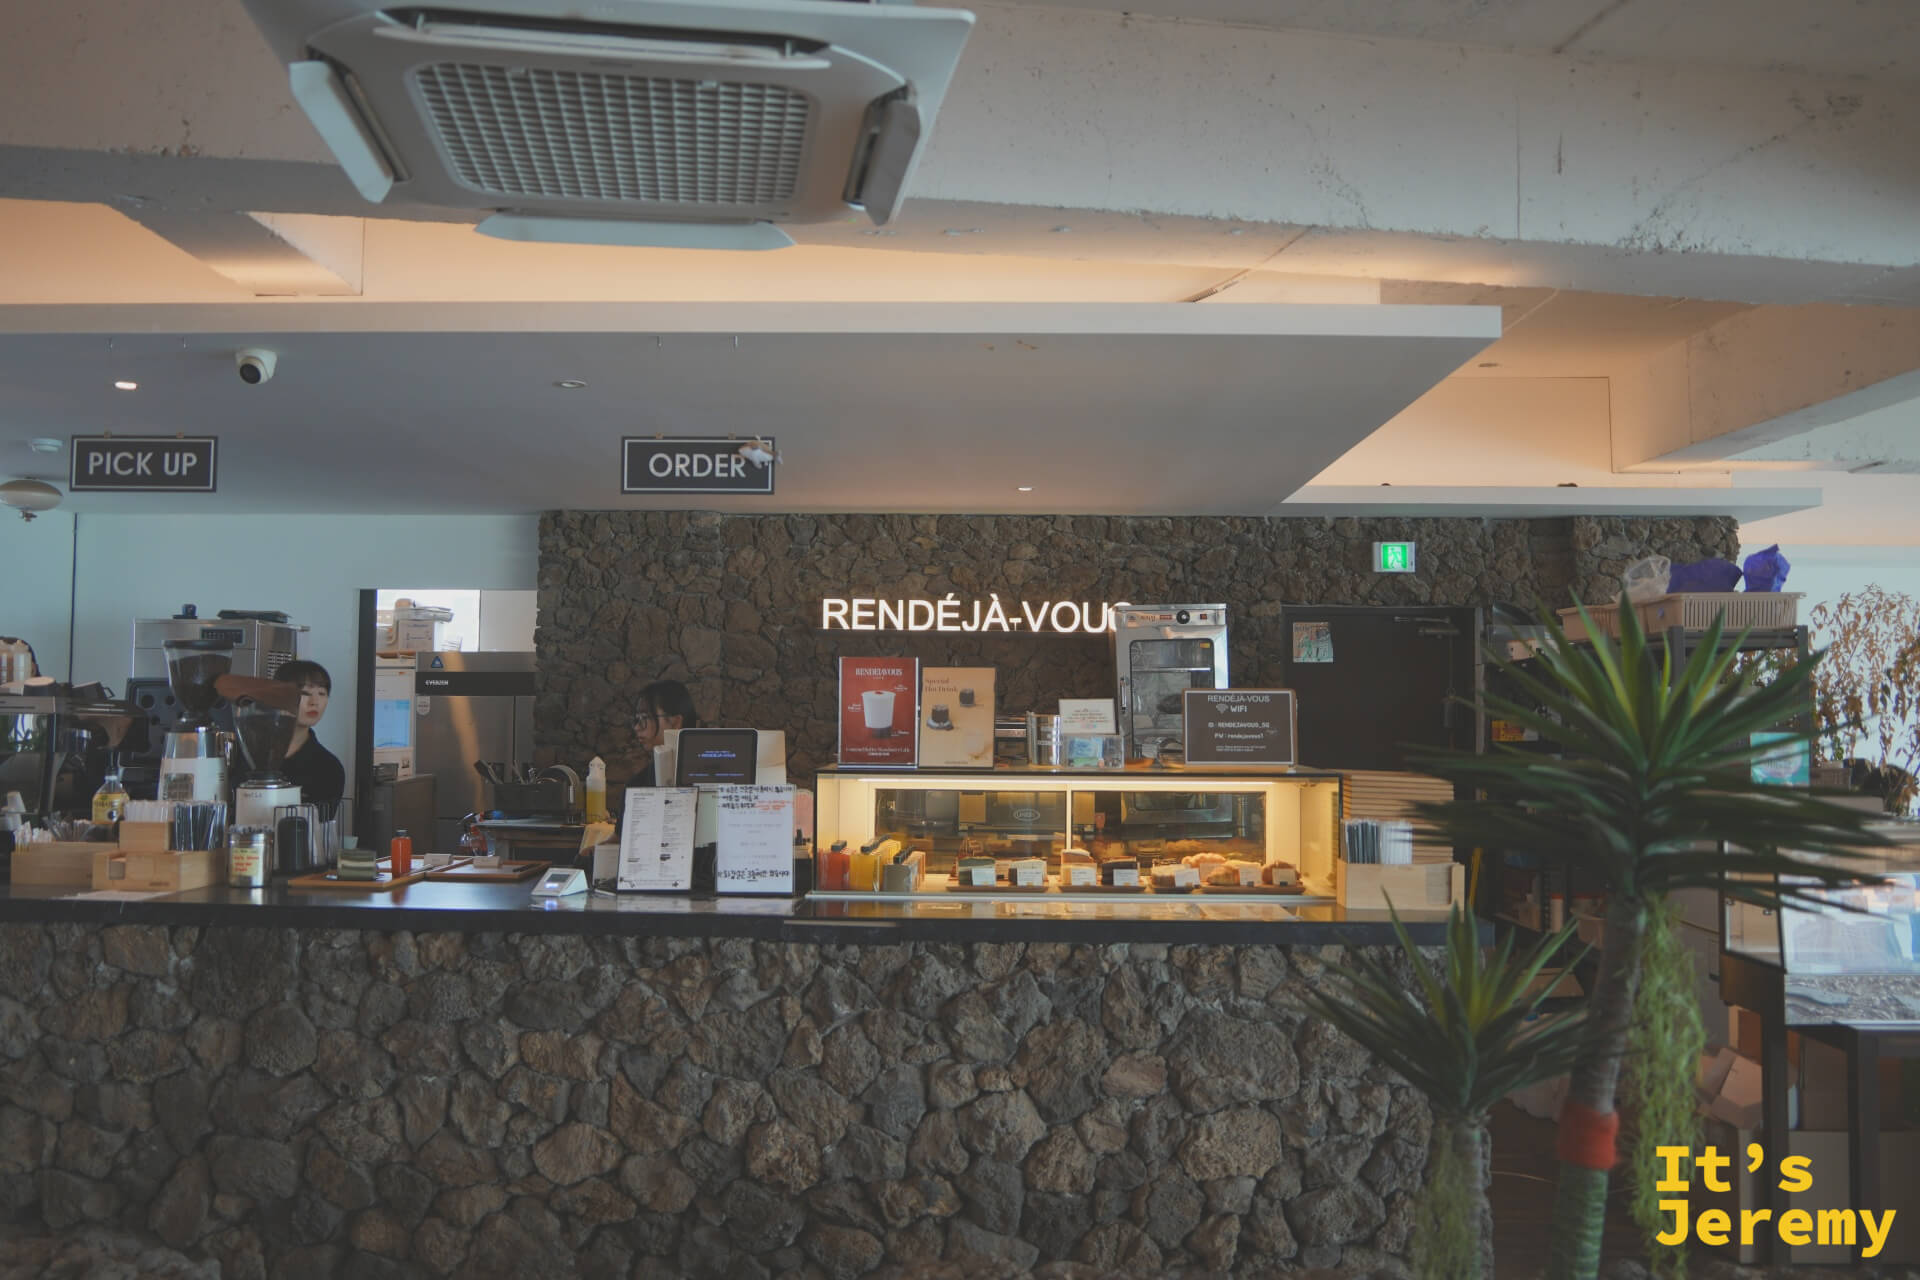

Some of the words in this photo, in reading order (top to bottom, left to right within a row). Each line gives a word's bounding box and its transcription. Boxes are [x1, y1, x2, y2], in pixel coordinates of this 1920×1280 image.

[88, 452, 154, 475] PICK
[163, 452, 198, 476] UP
[648, 453, 747, 477] ORDER
[821, 593, 1132, 633] RENDÉJÀ-VOU
